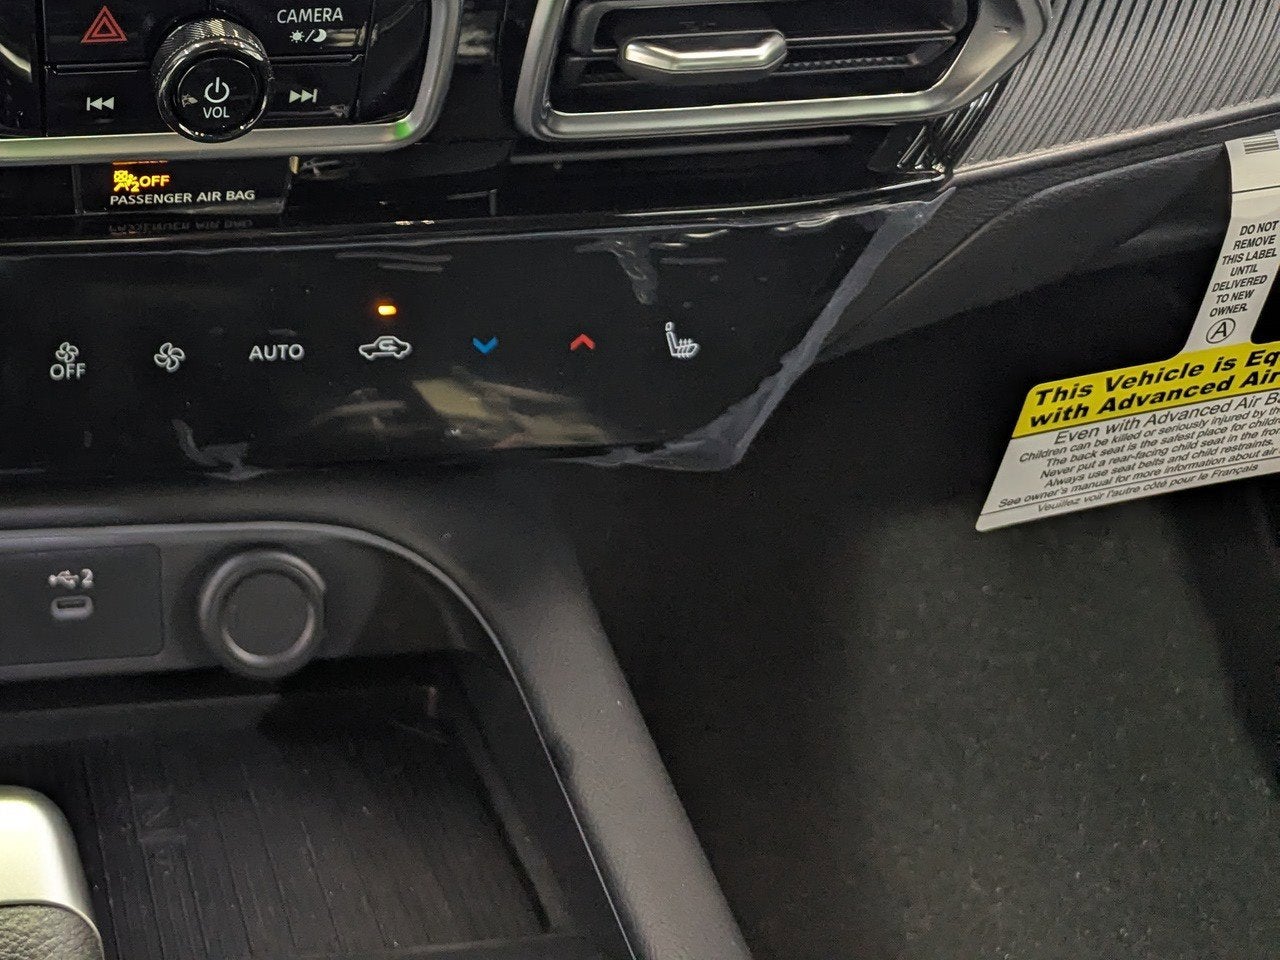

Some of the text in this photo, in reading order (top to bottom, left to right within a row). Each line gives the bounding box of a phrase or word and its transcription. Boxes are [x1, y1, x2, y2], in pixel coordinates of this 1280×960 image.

[277, 7, 344, 24] CAMERA
[203, 106, 230, 119] VOL
[140, 175, 170, 188] OFF
[110, 190, 256, 205] PASSENGER AIR BAG
[1240, 220, 1280, 236] DO NOT
[1233, 235, 1277, 250] REMOVE
[1222, 247, 1278, 265] THIS LABEL
[1230, 264, 1258, 277] UNTIL
[1211, 275, 1268, 293] DELIVERED
[1216, 289, 1255, 304] TO NEW
[249, 343, 305, 361] AUTO
[50, 363, 86, 381] OFF
[1035, 382, 1093, 406] This
[1106, 362, 1205, 393] Vehicle
[1212, 356, 1238, 373] is
[1030, 369, 1280, 428] with Advanced Air
[1054, 427, 1100, 445] Even
[1106, 417, 1141, 435] with
[1142, 399, 1233, 428] Advanced
[1234, 395, 1262, 411] Air
[1019, 446, 1068, 463] Children
[1070, 441, 1091, 452] can
[1094, 439, 1109, 448] be
[1111, 430, 1142, 444] killed
[1143, 429, 1157, 438] or
[1158, 419, 1209, 435] seriously
[1211, 411, 1251, 425] injured
[1252, 409, 1268, 419] by
[1047, 457, 1068, 467] The
[1070, 450, 1098, 462] back
[1100, 445, 1126, 456] seat
[1127, 442, 1138, 451] is
[1140, 439, 1158, 449] the
[1160, 431, 1195, 445] safest
[1196, 426, 1228, 440] place
[1231, 423, 1247, 432] for
[1040, 466, 1075, 479] Never
[1076, 460, 1096, 473] put
[1108, 447, 1169, 465] rear-facing
[1171, 440, 1199, 453] child
[1200, 436, 1226, 447] seat
[1226, 434, 1238, 442] in
[1240, 431, 1259, 441] the
[1044, 474, 1085, 488] Always
[1088, 469, 1108, 479] use
[1111, 463, 1136, 475] seat
[1138, 458, 1165, 469] belts
[1166, 451, 1190, 464] and
[1192, 447, 1218, 460] child
[1115, 474, 1131, 483] for
[1132, 469, 1161, 480] more
[1228, 450, 1261, 462] about
[81, 568, 94, 589] 2
